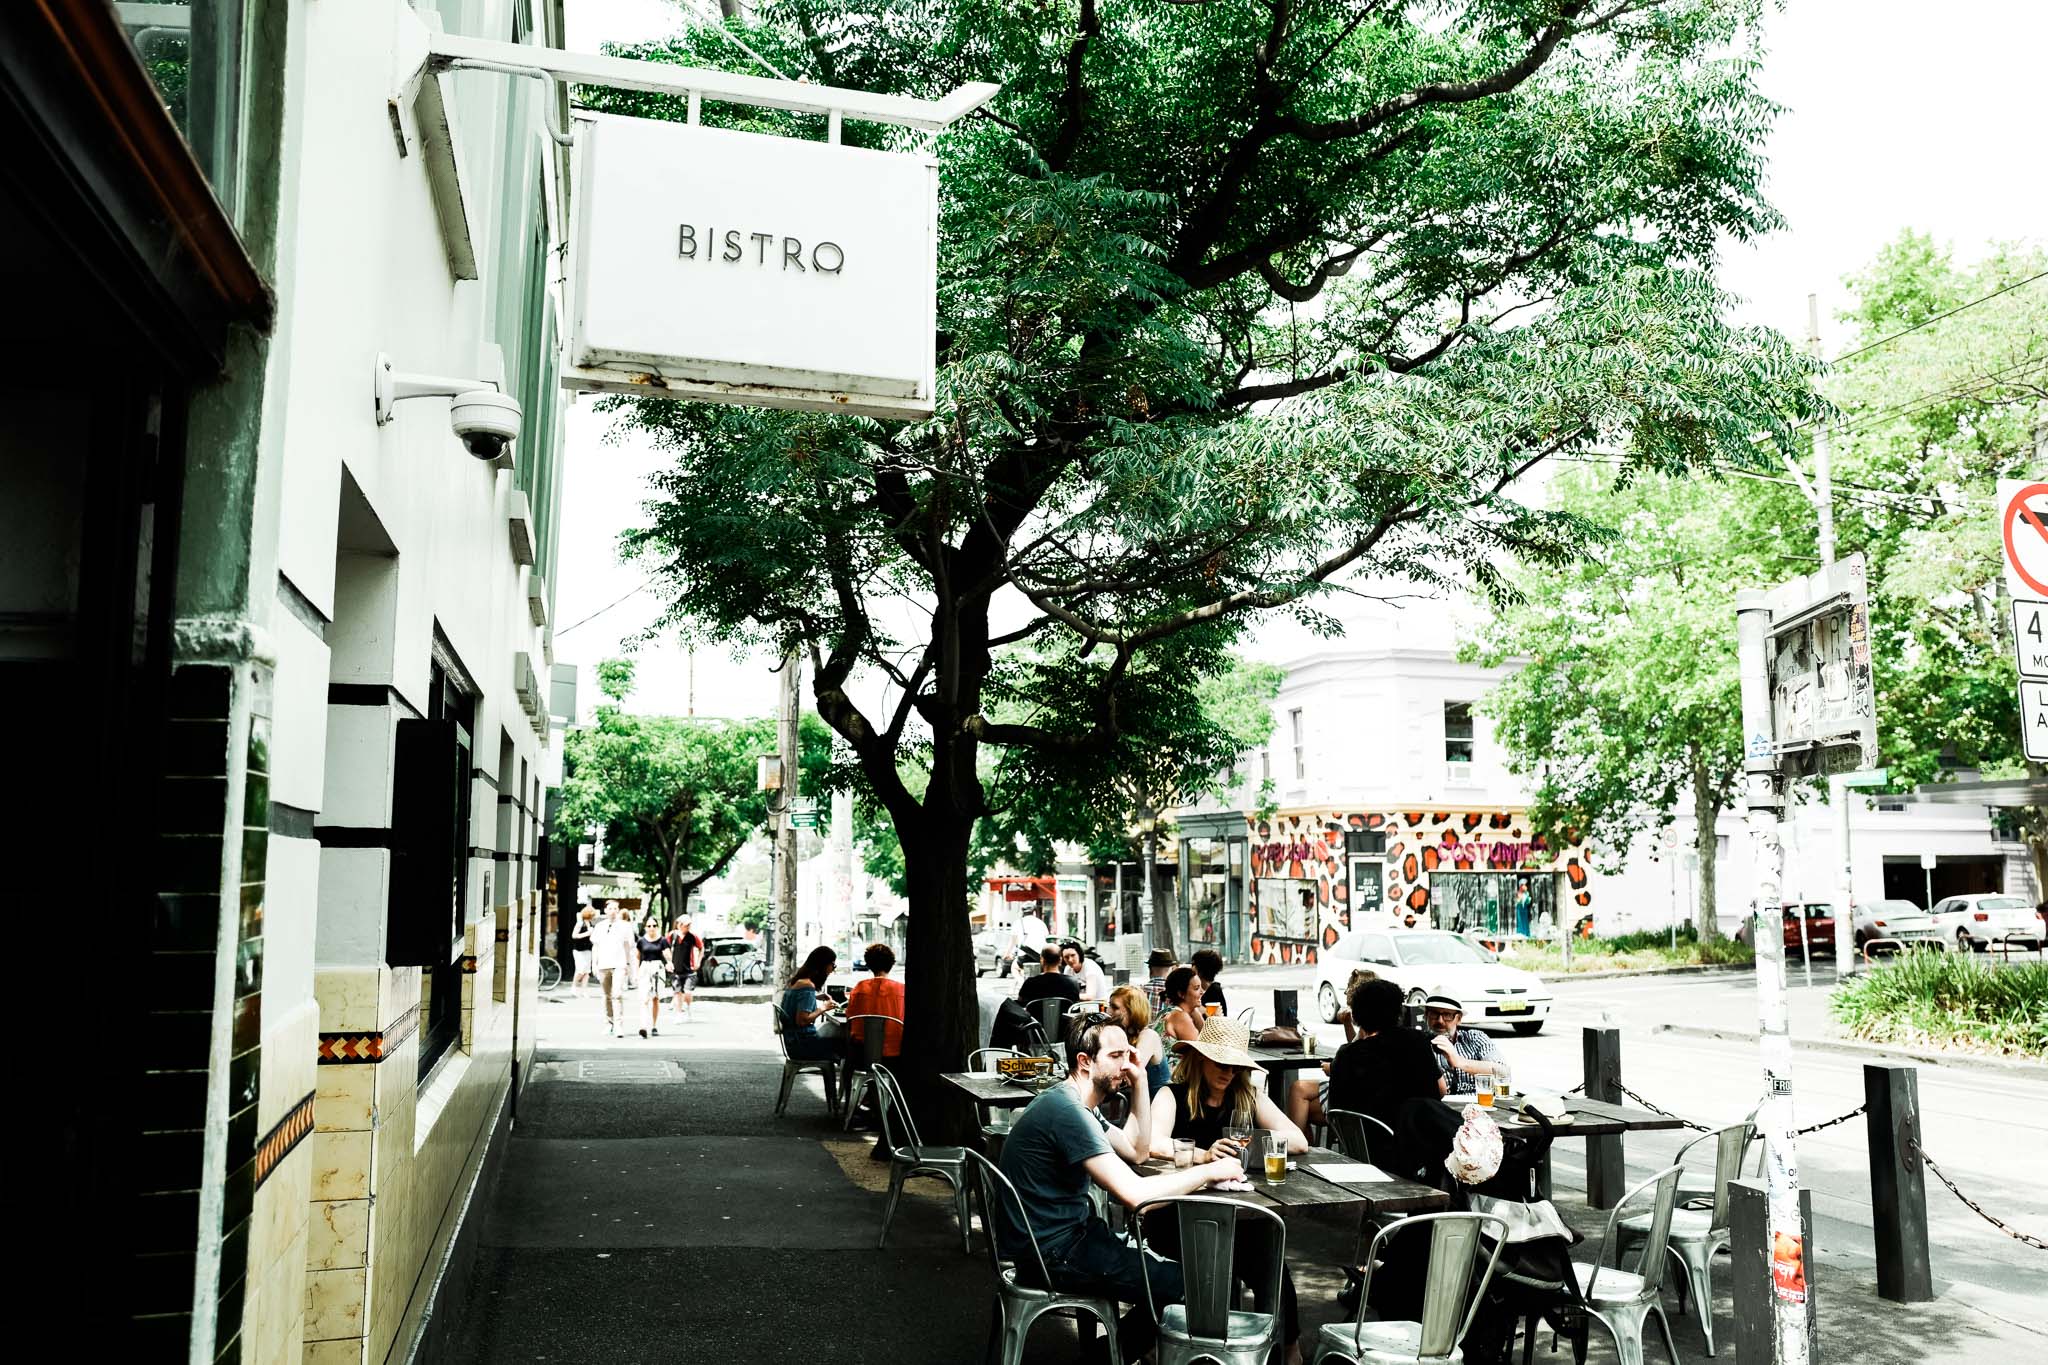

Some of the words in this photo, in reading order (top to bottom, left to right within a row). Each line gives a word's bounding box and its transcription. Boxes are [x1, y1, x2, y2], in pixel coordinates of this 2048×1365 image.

[679, 223, 845, 274] BISTRO
[1437, 842, 1560, 863] COSTUMIE
[1001, 1060, 1037, 1071] Schw
